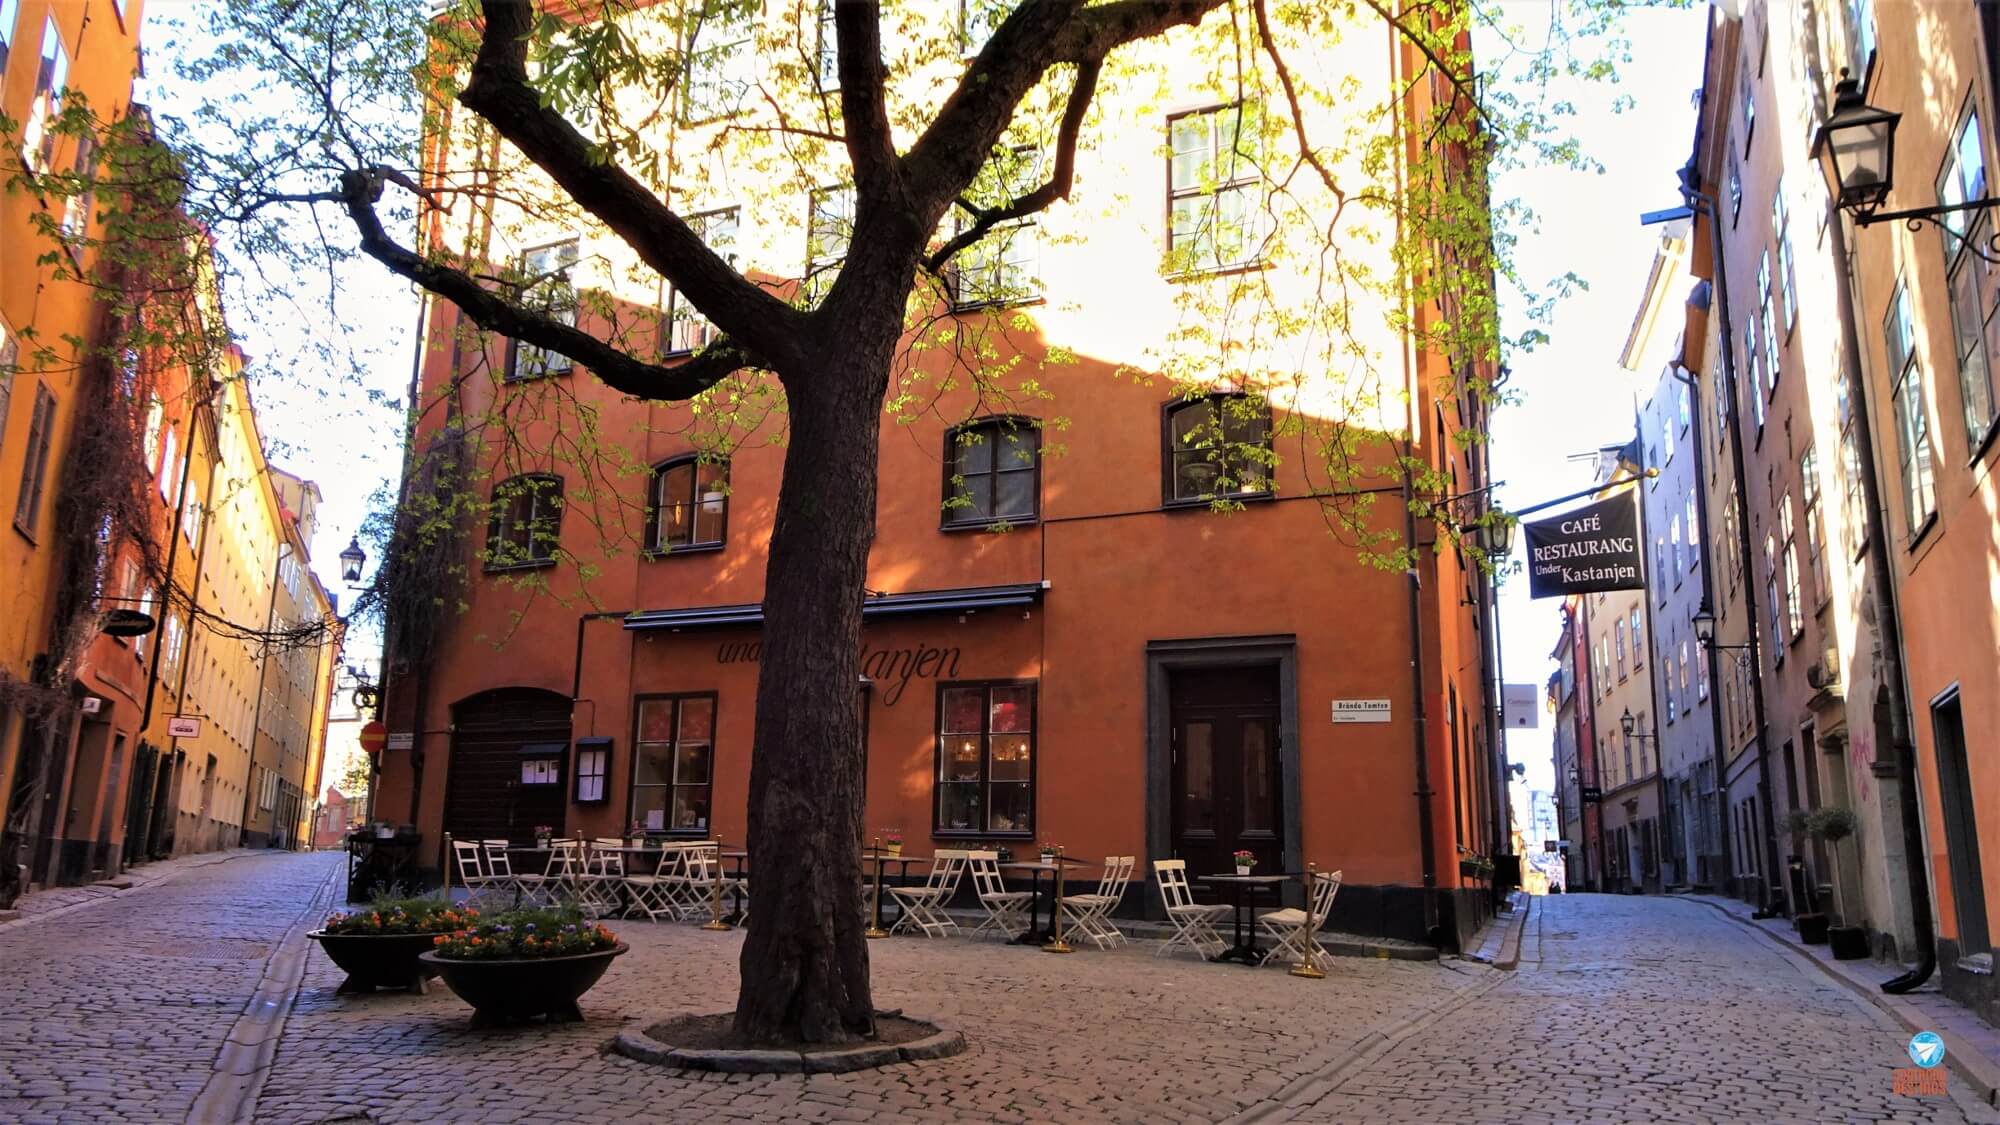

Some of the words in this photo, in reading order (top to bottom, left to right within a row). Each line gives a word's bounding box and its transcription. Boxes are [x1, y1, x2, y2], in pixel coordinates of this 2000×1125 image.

[1561, 514, 1601, 535] CAFÉ
[1534, 537, 1633, 562] RESTAURANG
[1535, 564, 1562, 576] Under
[1562, 563, 1636, 584] Kastanjen
